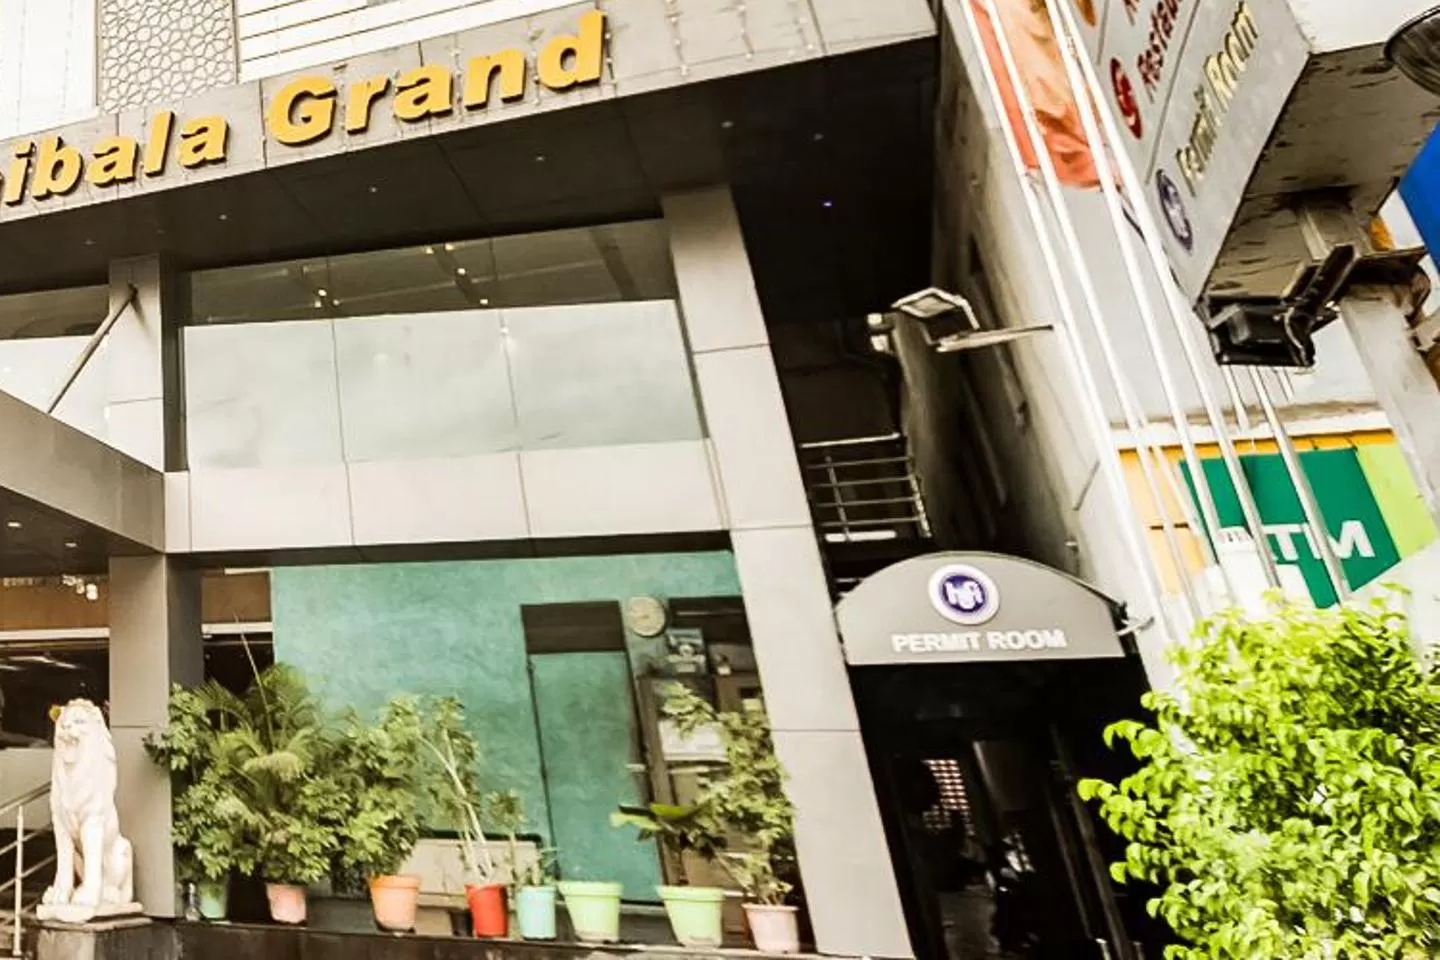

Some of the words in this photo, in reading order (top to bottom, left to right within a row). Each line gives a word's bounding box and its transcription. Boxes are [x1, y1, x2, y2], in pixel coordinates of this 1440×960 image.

[265, 8, 610, 146] Grand
[1175, 84, 1221, 198] Permit
[1203, 0, 1260, 115] Room
[891, 631, 981, 653] PERMIT
[986, 628, 1068, 650] ROOM
